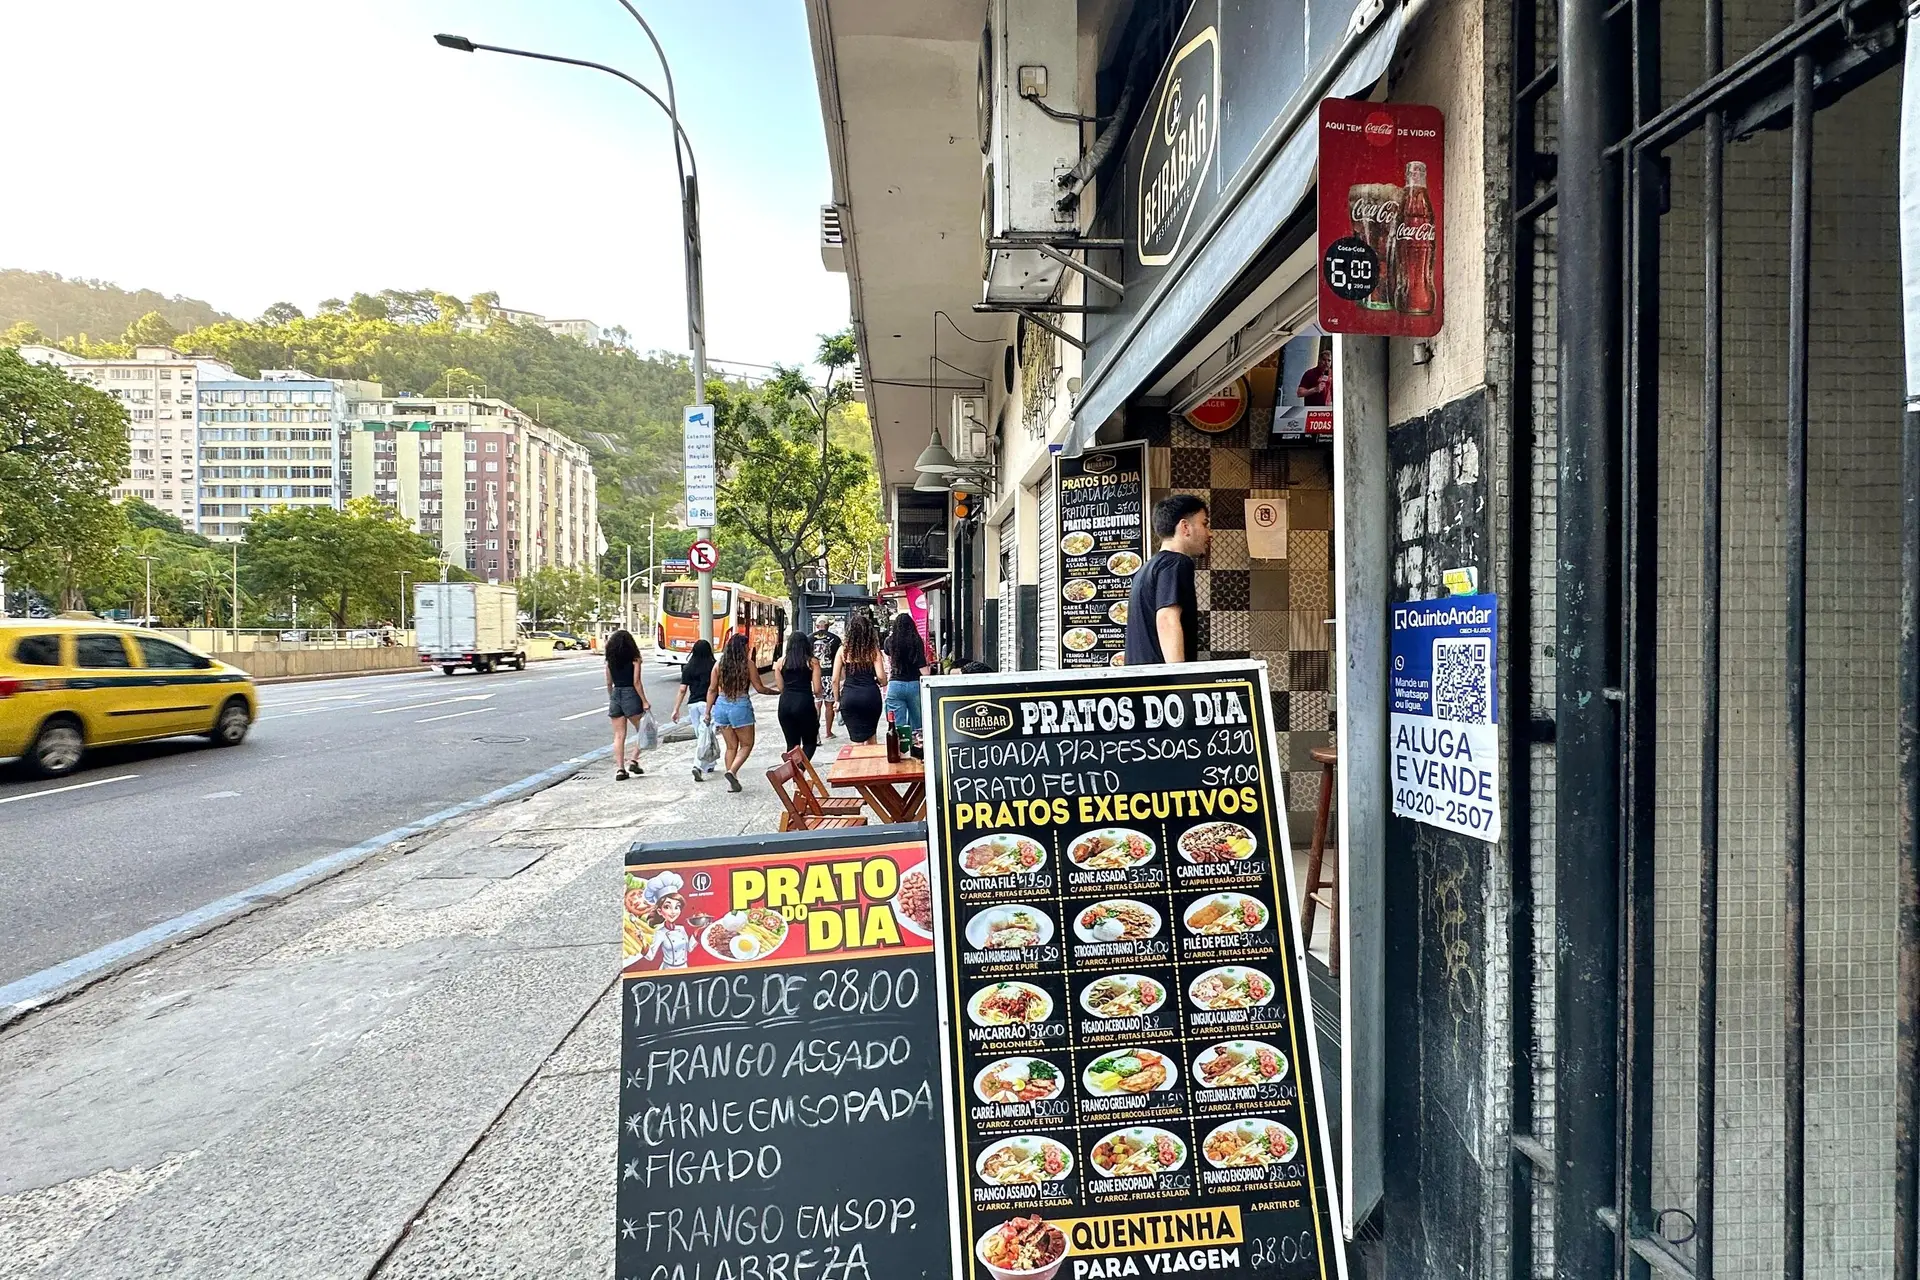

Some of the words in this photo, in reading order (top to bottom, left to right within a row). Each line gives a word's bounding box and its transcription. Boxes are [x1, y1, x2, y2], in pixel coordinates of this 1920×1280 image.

[1325, 122, 1344, 130] AQUI
[1346, 124, 1362, 132] TEM
[1410, 129, 1436, 137] VIDRO
[1144, 94, 1207, 246] BEIRABAR
[1155, 185, 1191, 245] RESTAURANTE
[1310, 421, 1331, 430] TODAS
[1062, 476, 1099, 490] PRATOS
[1102, 474, 1118, 485] DO
[1121, 472, 1140, 483] DIA
[1061, 487, 1100, 506] FEIJOADA
[1062, 505, 1085, 520] PRATO
[1086, 502, 1109, 517] FEITO
[1063, 518, 1092, 531] PRATOS
[1093, 513, 1140, 529] EXECUTIVOS
[1408, 606, 1492, 628] QuintoAndar
[1395, 677, 1416, 689] Mande
[1417, 680, 1428, 688] um
[1395, 688, 1428, 701] Whatsapp
[1020, 698, 1137, 735] PRATOS
[1145, 695, 1184, 729] DO
[1193, 690, 1247, 726] DIA
[1395, 700, 1404, 709] ou
[1405, 699, 1422, 711] ligue.
[960, 716, 1006, 728] BEIRABAR
[1395, 724, 1473, 762] ALUGA
[949, 741, 1050, 774] FEIJOADA
[1100, 738, 1201, 764] PESSOAS
[953, 775, 1036, 801] PRATO
[1044, 770, 1120, 796] FEITO
[1397, 755, 1408, 781] E
[1413, 757, 1493, 802] VENDE
[956, 797, 1070, 830] PRATOS
[1080, 786, 1258, 823] EXECUTIVOS
[1396, 787, 1494, 832] 4020-2507
[1069, 871, 1095, 884] CARNE
[1096, 869, 1127, 883] ASSADA
[1177, 865, 1204, 878] CARNE
[1204, 864, 1215, 876] DE
[1216, 863, 1232, 875] SOL
[732, 858, 898, 910] PRATO
[960, 877, 997, 890] CONTRA
[999, 873, 1016, 889] FILÉ
[1189, 877, 1209, 885] AIPIM
[1214, 875, 1235, 884] BAIÃO
[1246, 874, 1262, 882] DOIS
[783, 903, 807, 922] DO
[807, 904, 901, 952] DIA
[1113, 942, 1133, 954] FRANGO
[1183, 935, 1203, 950] FILÉ
[1204, 936, 1214, 948] DE
[1214, 934, 1240, 948] PEIXE
[964, 951, 984, 964] FRANGO
[1140, 954, 1166, 962] SALADA
[631, 974, 755, 1027] PRATOS
[761, 973, 807, 1015] DE
[812, 967, 920, 1015] 28,00
[1082, 1019, 1104, 1034] FÍGADO
[1105, 1018, 1140, 1032] ACEBOLADO
[1190, 1013, 1217, 1026] LINGUIÇA
[1217, 1010, 1248, 1024] CALABRESA
[1255, 1022, 1282, 1030] SALADA
[969, 1024, 1026, 1041] MACARRÃO
[990, 1039, 1045, 1049] BOLONHESA
[646, 1041, 777, 1091] FRANGO
[781, 1035, 911, 1079] ASSADO
[1195, 1088, 1229, 1103] COSTELINHA
[1229, 1089, 1237, 1101] DE
[1238, 1086, 1257, 1100] PORCO
[971, 1103, 994, 1120] CARRÉ
[1001, 1102, 1031, 1118] MINEIRA
[1081, 1098, 1109, 1112] FRANGO
[1110, 1095, 1146, 1110] GRELHADO
[1235, 1102, 1258, 1110] FRITAS
[1264, 1099, 1292, 1107] SALADA
[643, 1099, 743, 1147] CARNE
[1014, 1119, 1038, 1127] COUVE
[1090, 1113, 1111, 1121] ARROZ
[1156, 1108, 1183, 1116] LEGUMES
[646, 1144, 782, 1189] FIGADO
[1203, 1170, 1230, 1185] FRANGO
[1230, 1167, 1264, 1183] ENSOPADO
[974, 1187, 1006, 1201] FRANGO
[1006, 1185, 1037, 1199] ASSADO
[1089, 1179, 1114, 1194] CARNE
[1115, 1176, 1154, 1192] ENSOPADA
[1162, 1189, 1190, 1197] SALADA
[1245, 1183, 1268, 1191] FRITAS
[1274, 1180, 1301, 1189] SALADA
[1015, 1201, 1038, 1209] FRITAS
[1044, 1198, 1073, 1206] SALADA
[1251, 1203, 1258, 1211] A
[1258, 1201, 1288, 1211] PARTIR
[1289, 1200, 1300, 1208] DE
[645, 1204, 784, 1252] FRANGO
[1072, 1210, 1236, 1251] QUENTINHA
[1073, 1255, 1141, 1280] PARA
[1144, 1247, 1241, 1275] VIAGEM
